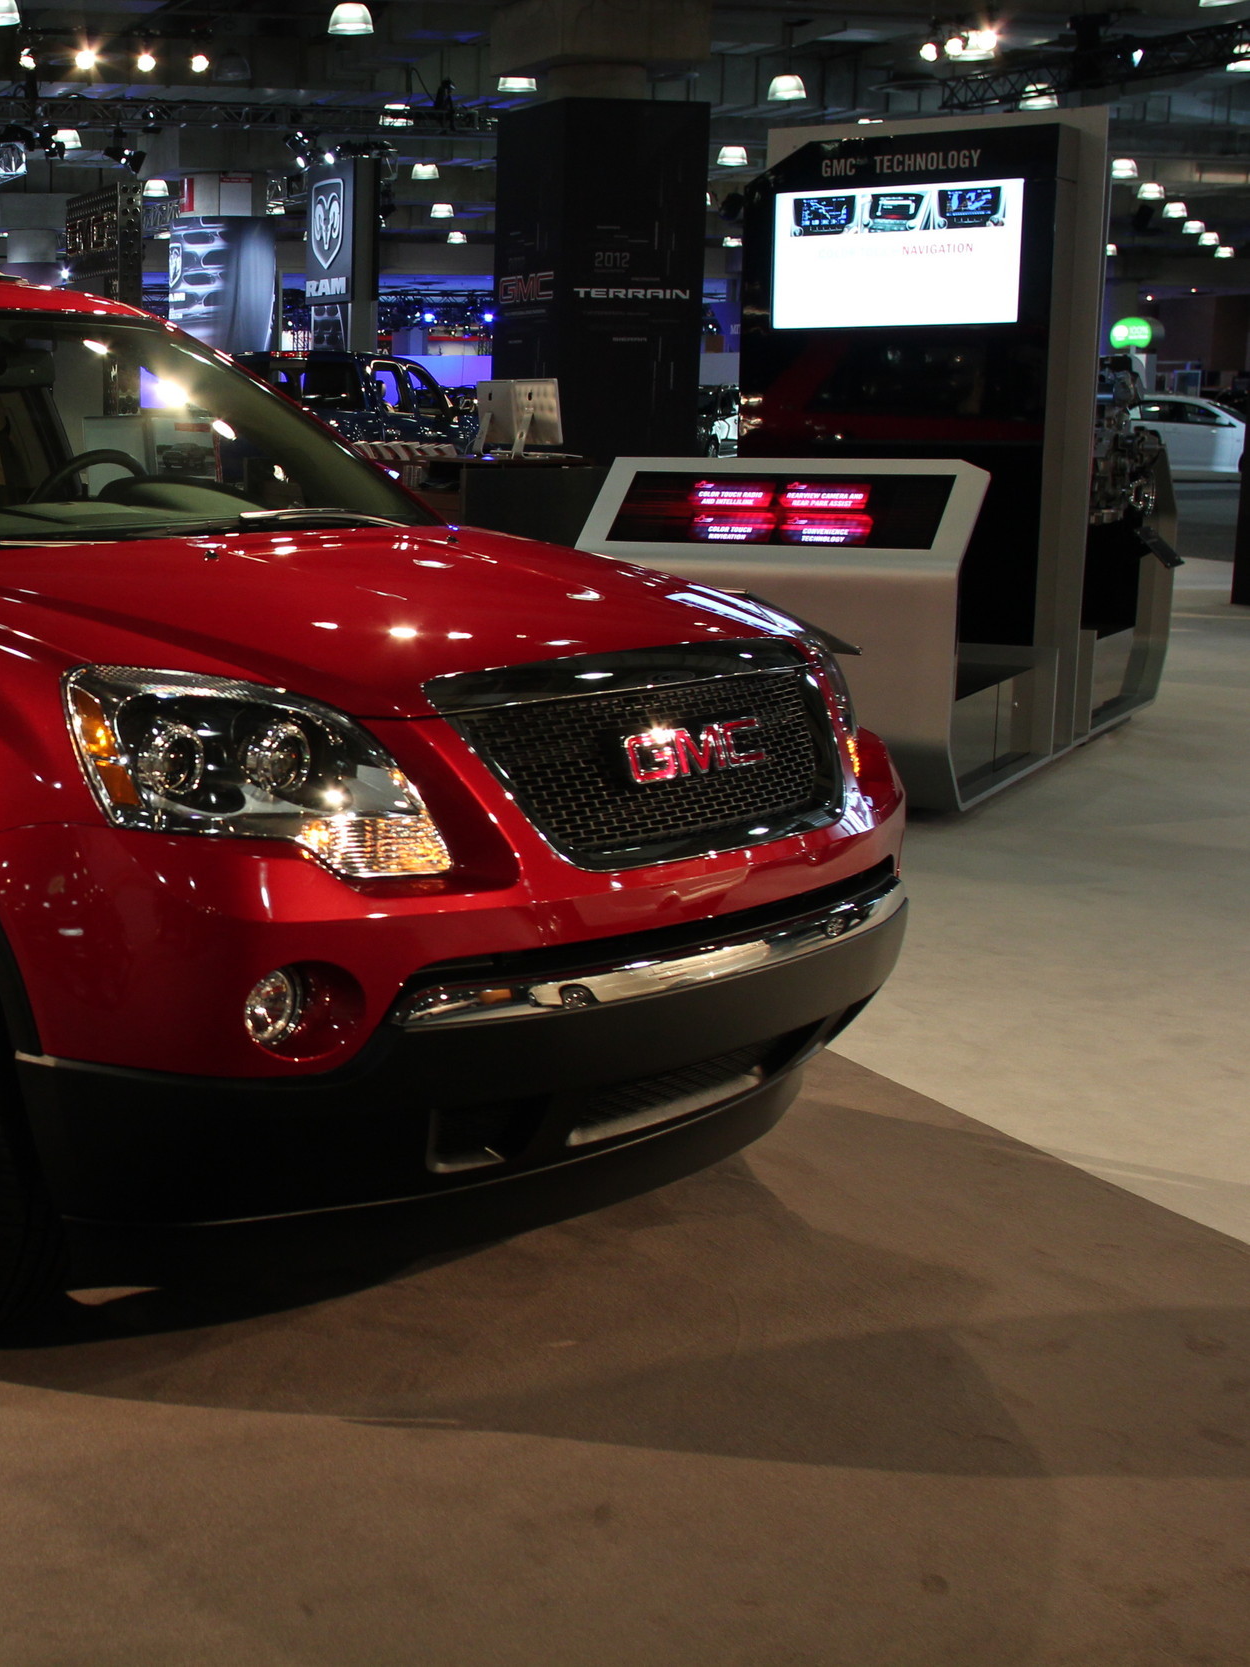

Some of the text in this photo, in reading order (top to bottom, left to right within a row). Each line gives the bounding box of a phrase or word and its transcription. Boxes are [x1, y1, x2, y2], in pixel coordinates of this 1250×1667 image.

[822, 149, 982, 177] GMC TECHNOLOGY
[594, 252, 630, 268] 2012
[902, 243, 974, 256] NAVIGATION
[306, 277, 347, 298] RAM
[499, 271, 555, 305] GMC
[573, 288, 691, 300] TERRAIN
[624, 716, 766, 784] GMC
